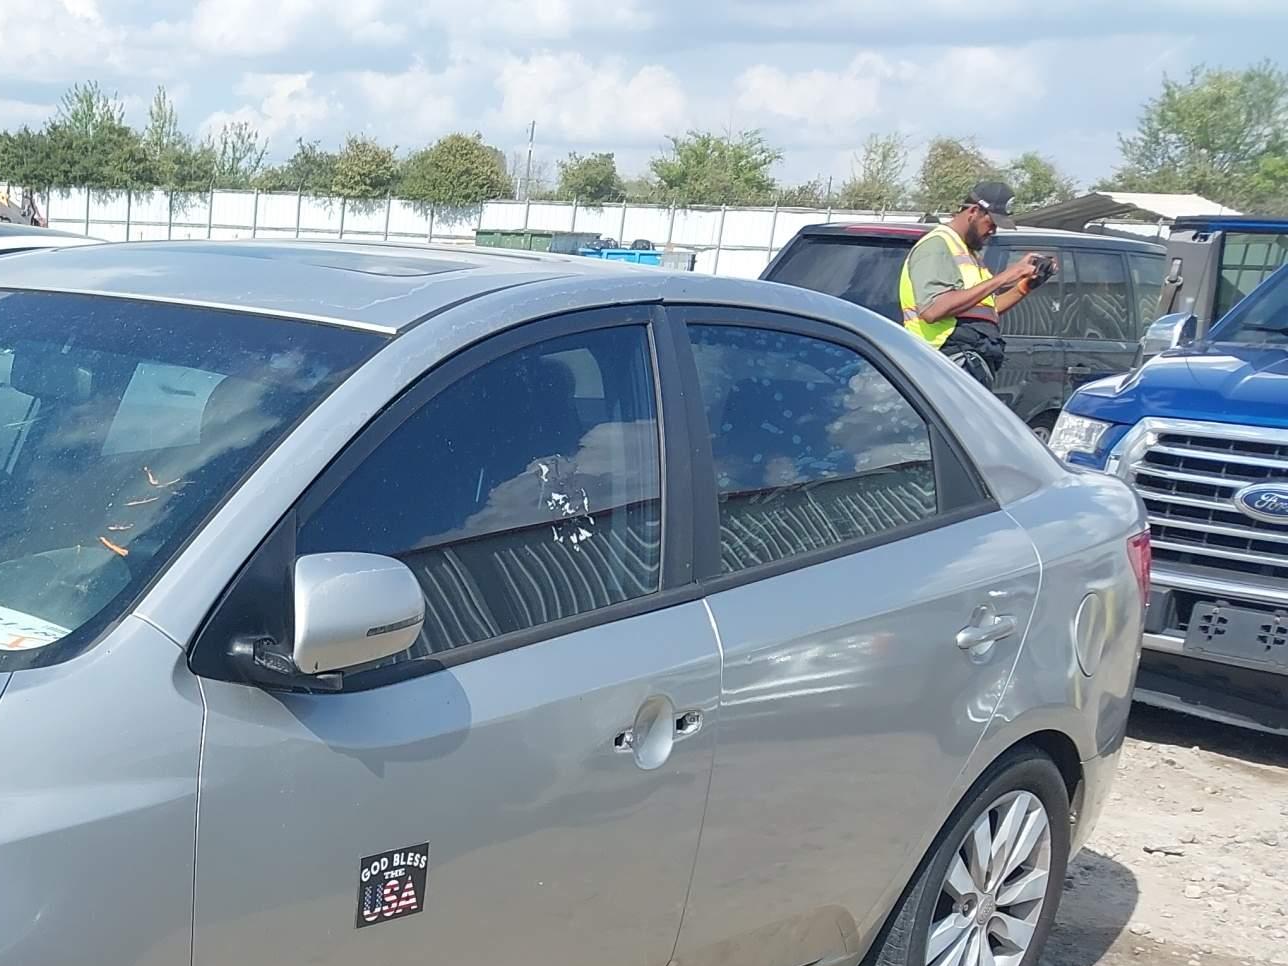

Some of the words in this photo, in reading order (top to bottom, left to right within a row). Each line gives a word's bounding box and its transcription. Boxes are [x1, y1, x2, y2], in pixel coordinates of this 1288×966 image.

[361, 857, 389, 882] GOD
[393, 852, 427, 869] BLESS
[383, 868, 406, 880] THE
[362, 874, 418, 922] USA
